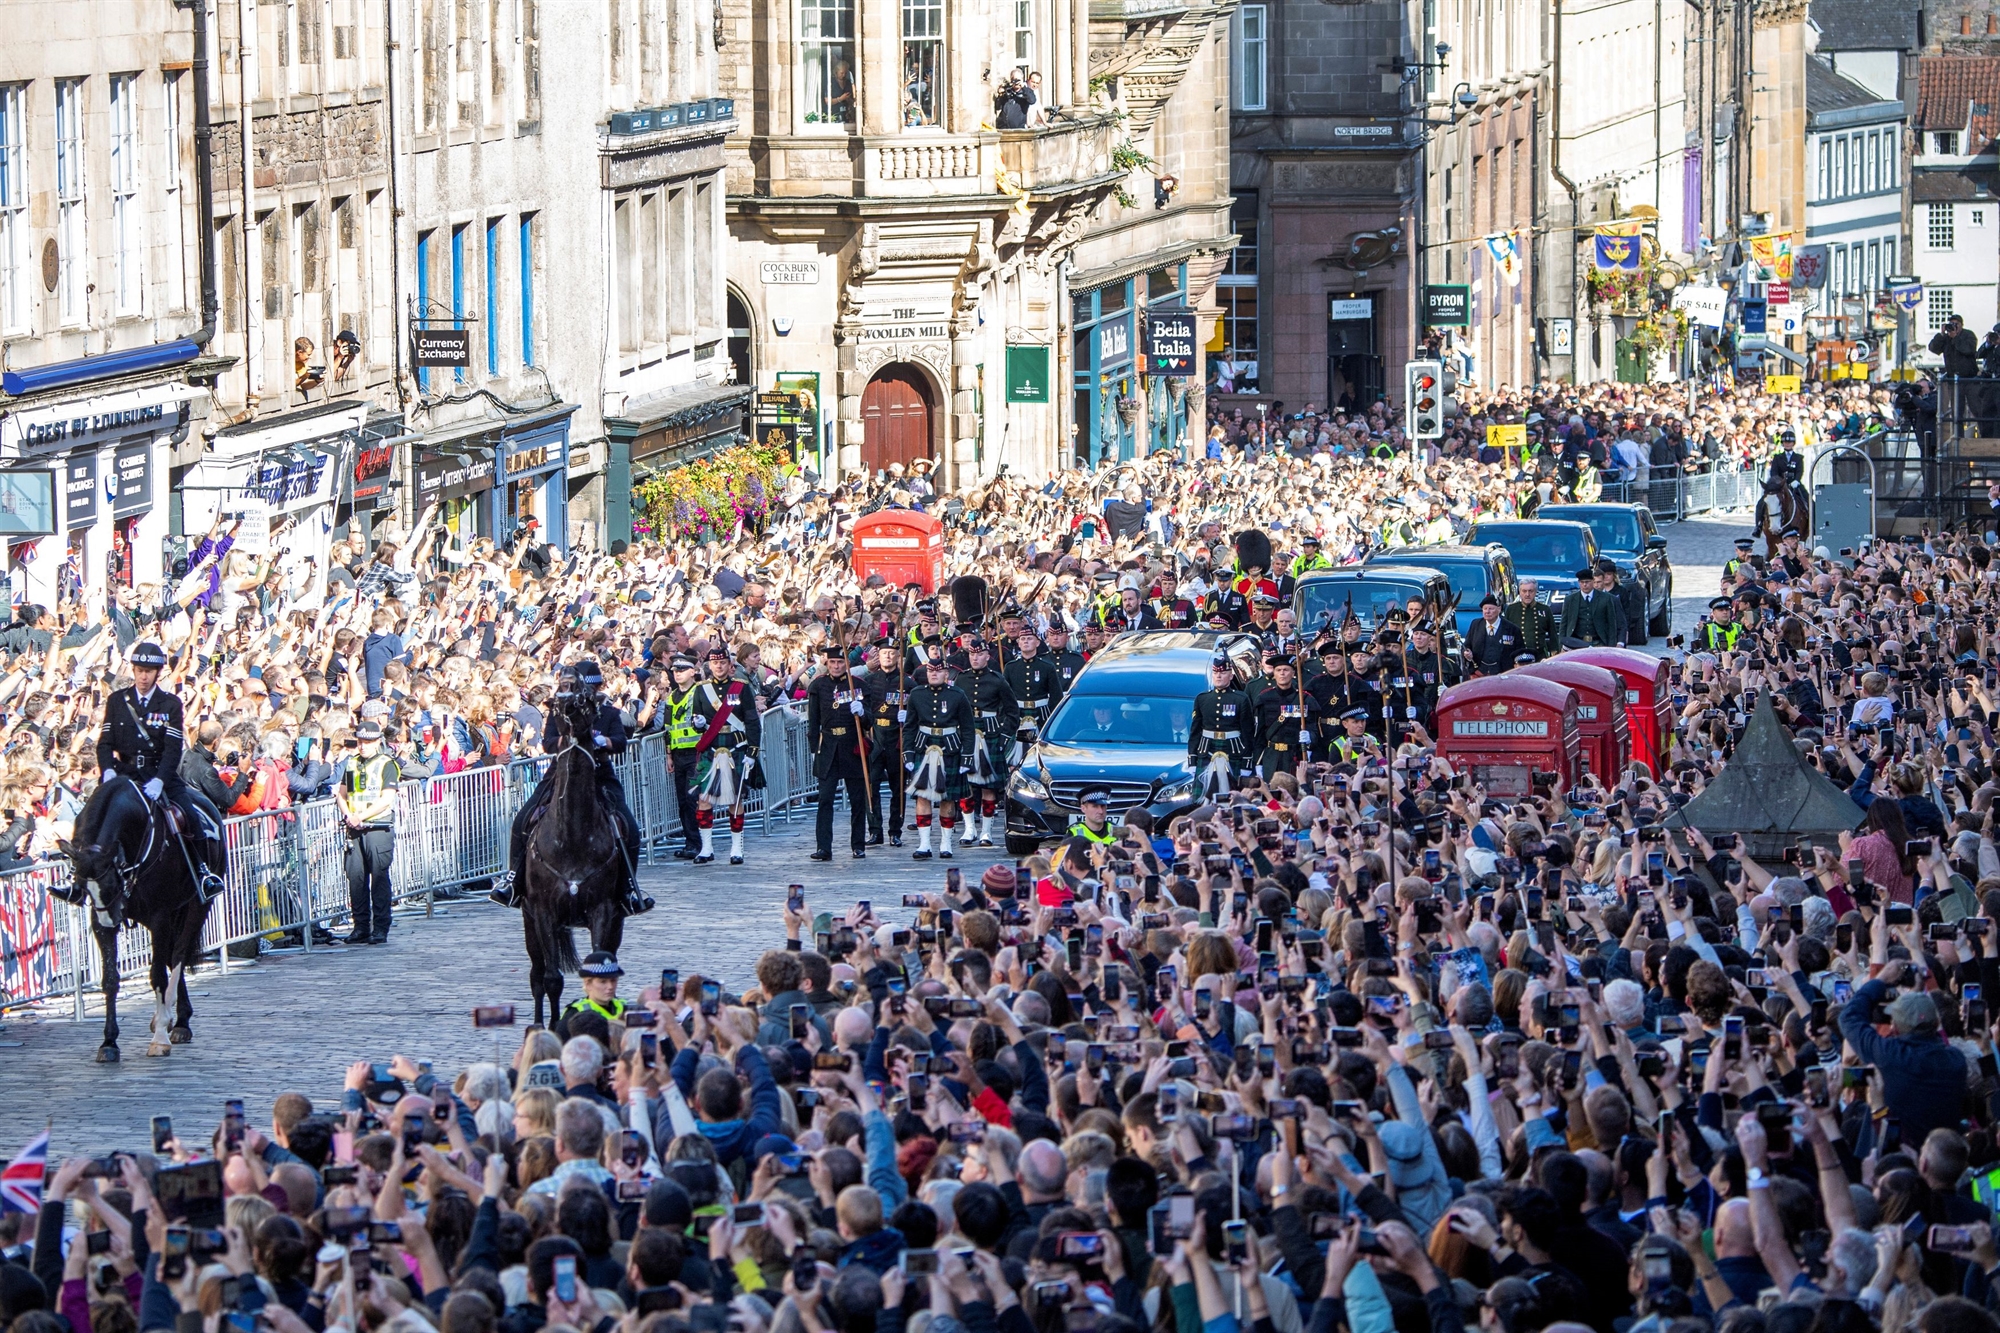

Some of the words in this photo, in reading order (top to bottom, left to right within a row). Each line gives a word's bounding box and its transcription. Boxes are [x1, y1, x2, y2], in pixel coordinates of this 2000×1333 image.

[1336, 127, 1361, 135] NORTH
[1363, 127, 1391, 135] BRIDGE
[763, 264, 817, 273] COCKBURN
[772, 273, 807, 282] STREET
[1430, 294, 1464, 307] BYRON
[1675, 300, 1693, 309] FOR
[1695, 301, 1721, 311] SALE
[892, 308, 916, 319] THE
[863, 326, 915, 340] WOOLLEN
[919, 325, 947, 338] MILL
[1153, 320, 1192, 338] Bella
[419, 338, 465, 350] Currency
[1101, 328, 1114, 360] Bella
[1113, 324, 1128, 354] Italia
[1152, 339, 1193, 356] Italia
[418, 349, 466, 360] Exchange
[761, 395, 791, 404] BELHAVEN
[26, 420, 68, 448] CREST
[71, 416, 90, 438] OF
[92, 403, 163, 435] EDINBURGH
[441, 469, 467, 488] Currency
[466, 460, 494, 480] Exchange
[67, 478, 95, 493] PACKAGES
[1457, 721, 1544, 735] TELEPHONE
